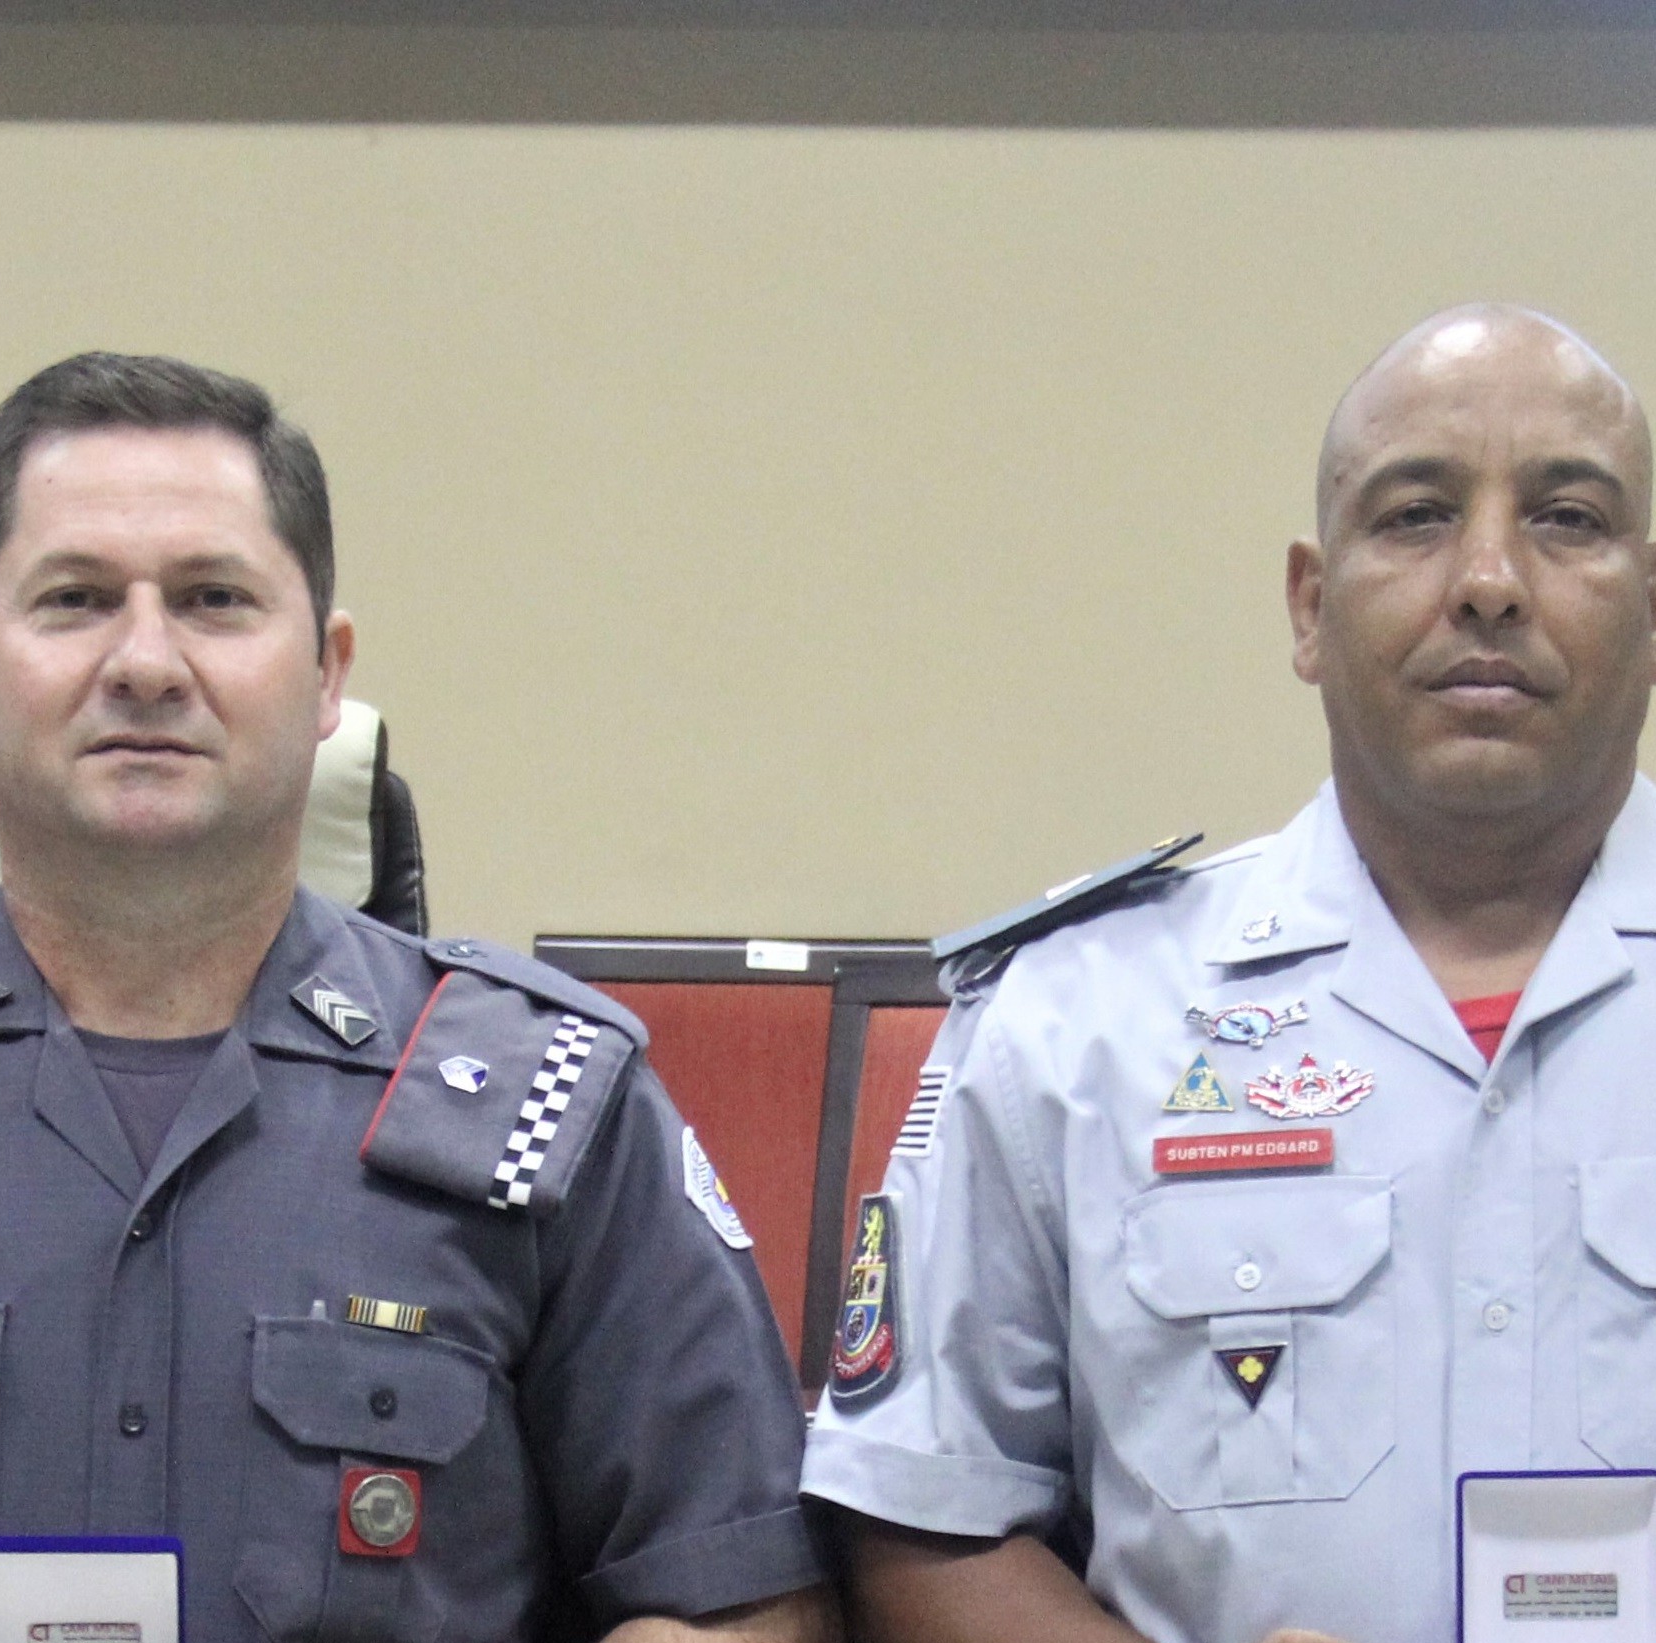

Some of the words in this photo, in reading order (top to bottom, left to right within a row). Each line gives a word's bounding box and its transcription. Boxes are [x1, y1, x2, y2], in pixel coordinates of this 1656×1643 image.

[1167, 1147, 1227, 1161] SUBTEN
[1230, 1145, 1252, 1156] PM
[1255, 1140, 1319, 1155] EDGARD
